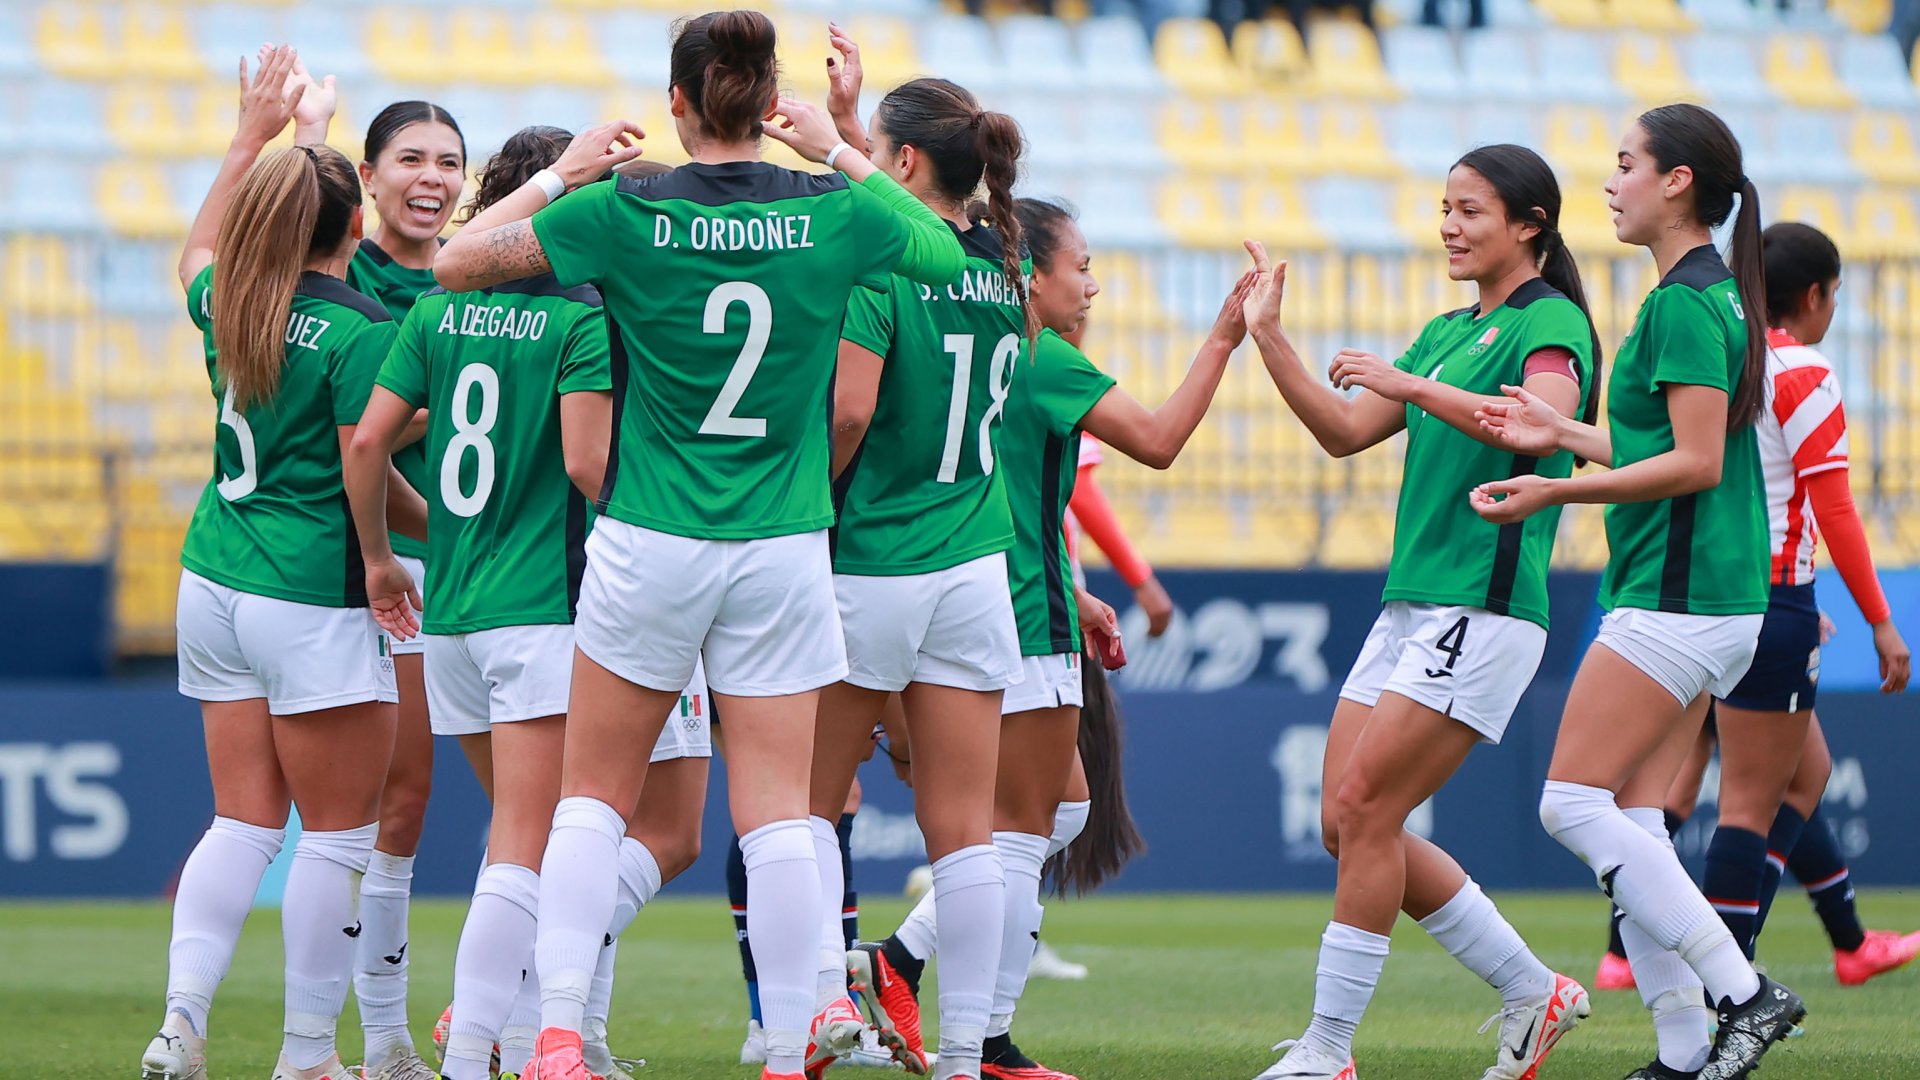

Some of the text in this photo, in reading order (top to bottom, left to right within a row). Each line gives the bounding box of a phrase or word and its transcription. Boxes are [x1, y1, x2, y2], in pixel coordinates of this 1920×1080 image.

[654, 210, 815, 251] D. ORDOÑEZ
[697, 280, 774, 438] 2
[936, 332, 1020, 484] 18
[216, 371, 258, 502] 5
[439, 361, 500, 518] 8
[1435, 615, 1470, 670] 4
